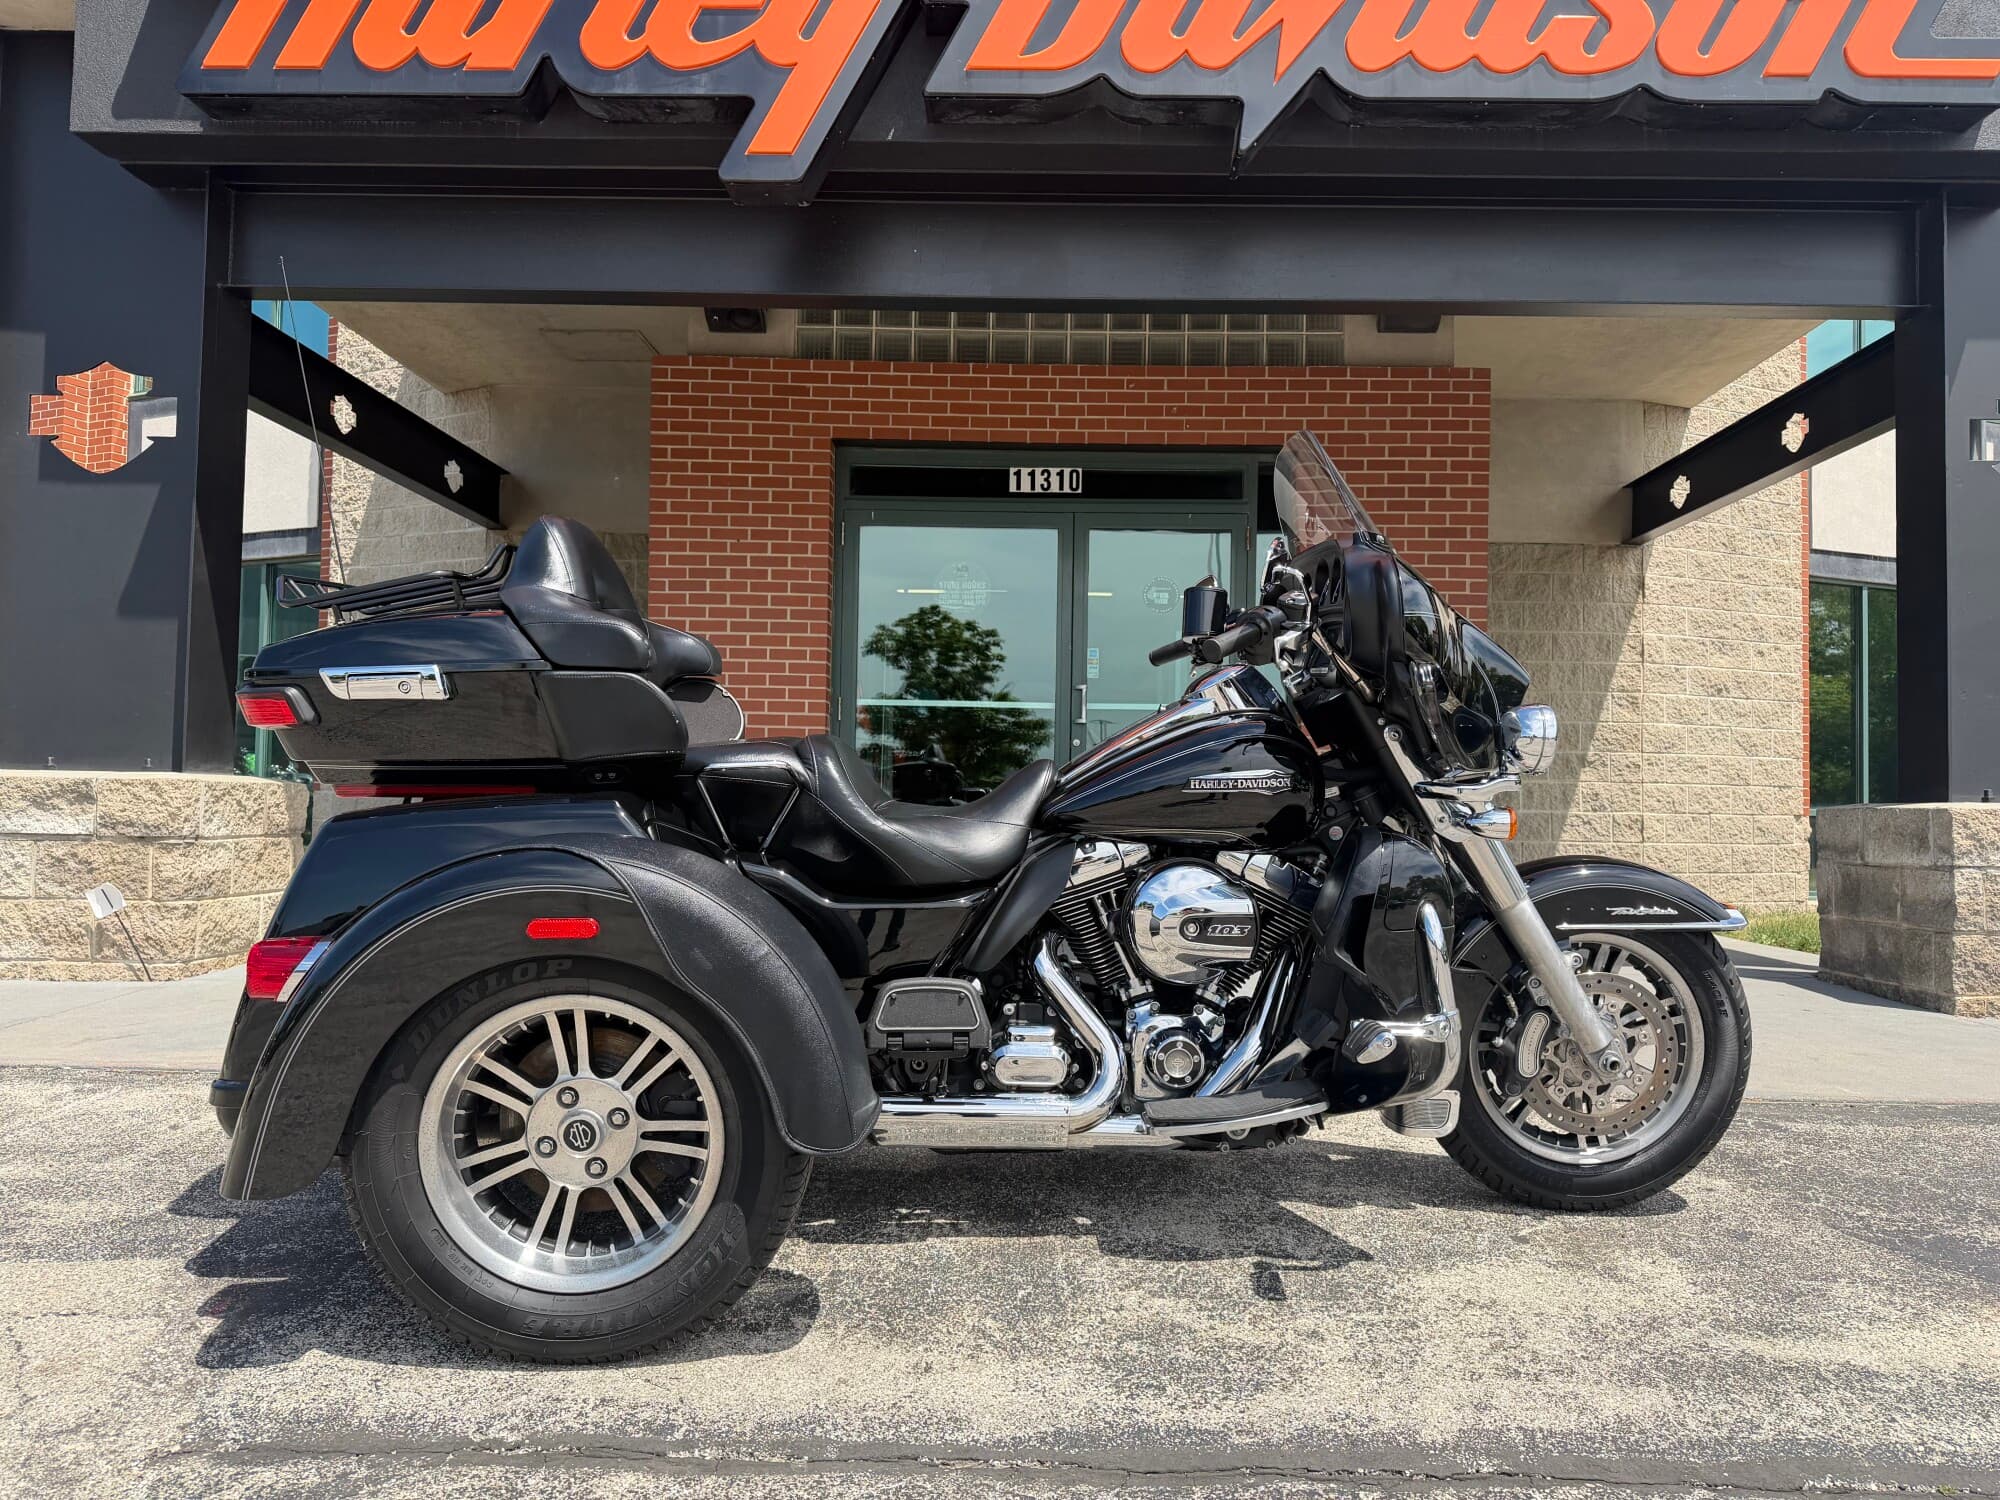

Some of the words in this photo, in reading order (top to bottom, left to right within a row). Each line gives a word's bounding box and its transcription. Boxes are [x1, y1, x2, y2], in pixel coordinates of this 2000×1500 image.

[1013, 469, 1080, 491] 11310
[1190, 777, 1291, 789] HARLEY-DAVIDSON
[1207, 924, 1251, 937] 103
[407, 958, 573, 1047] DUNLOP
